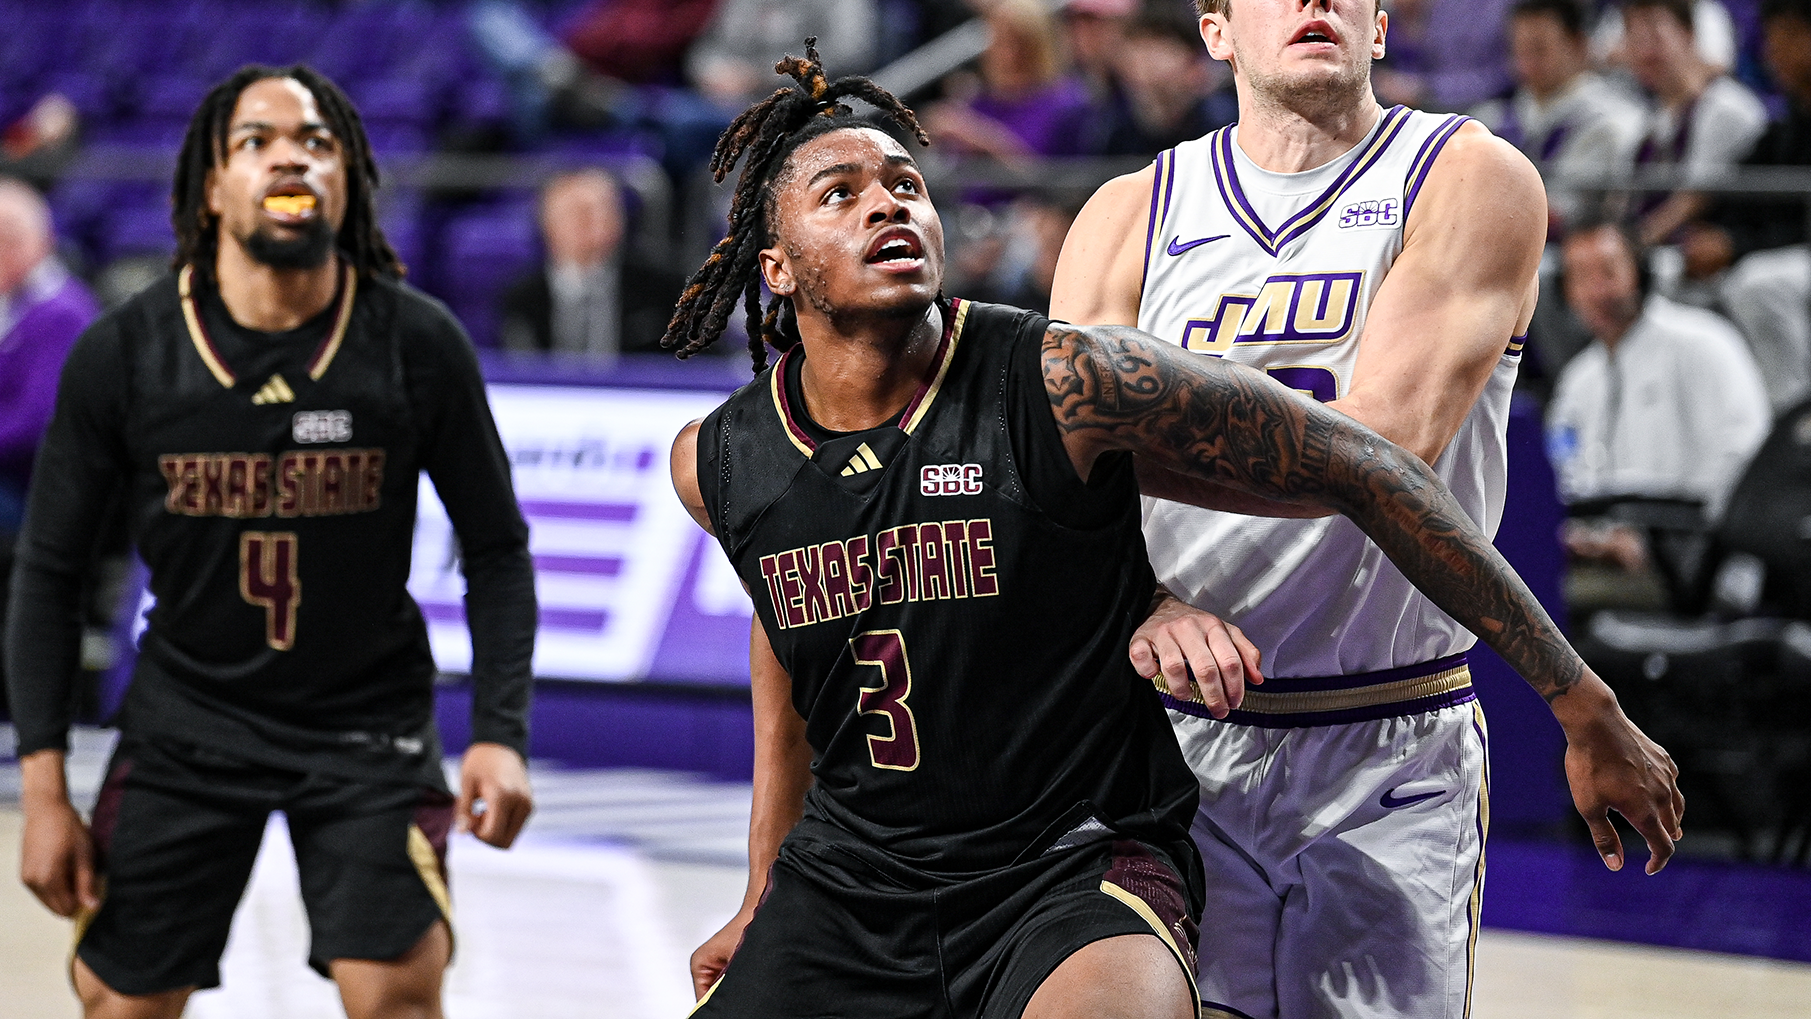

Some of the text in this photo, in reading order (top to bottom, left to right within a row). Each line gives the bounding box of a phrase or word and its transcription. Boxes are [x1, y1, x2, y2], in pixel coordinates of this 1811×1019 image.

[1338, 197, 1398, 229] SBC
[158, 447, 386, 518] TEXAS STATE
[920, 464, 983, 496] SBC
[239, 531, 302, 650] 4
[759, 518, 999, 630] TEXAS STATE
[849, 628, 920, 772] 3
